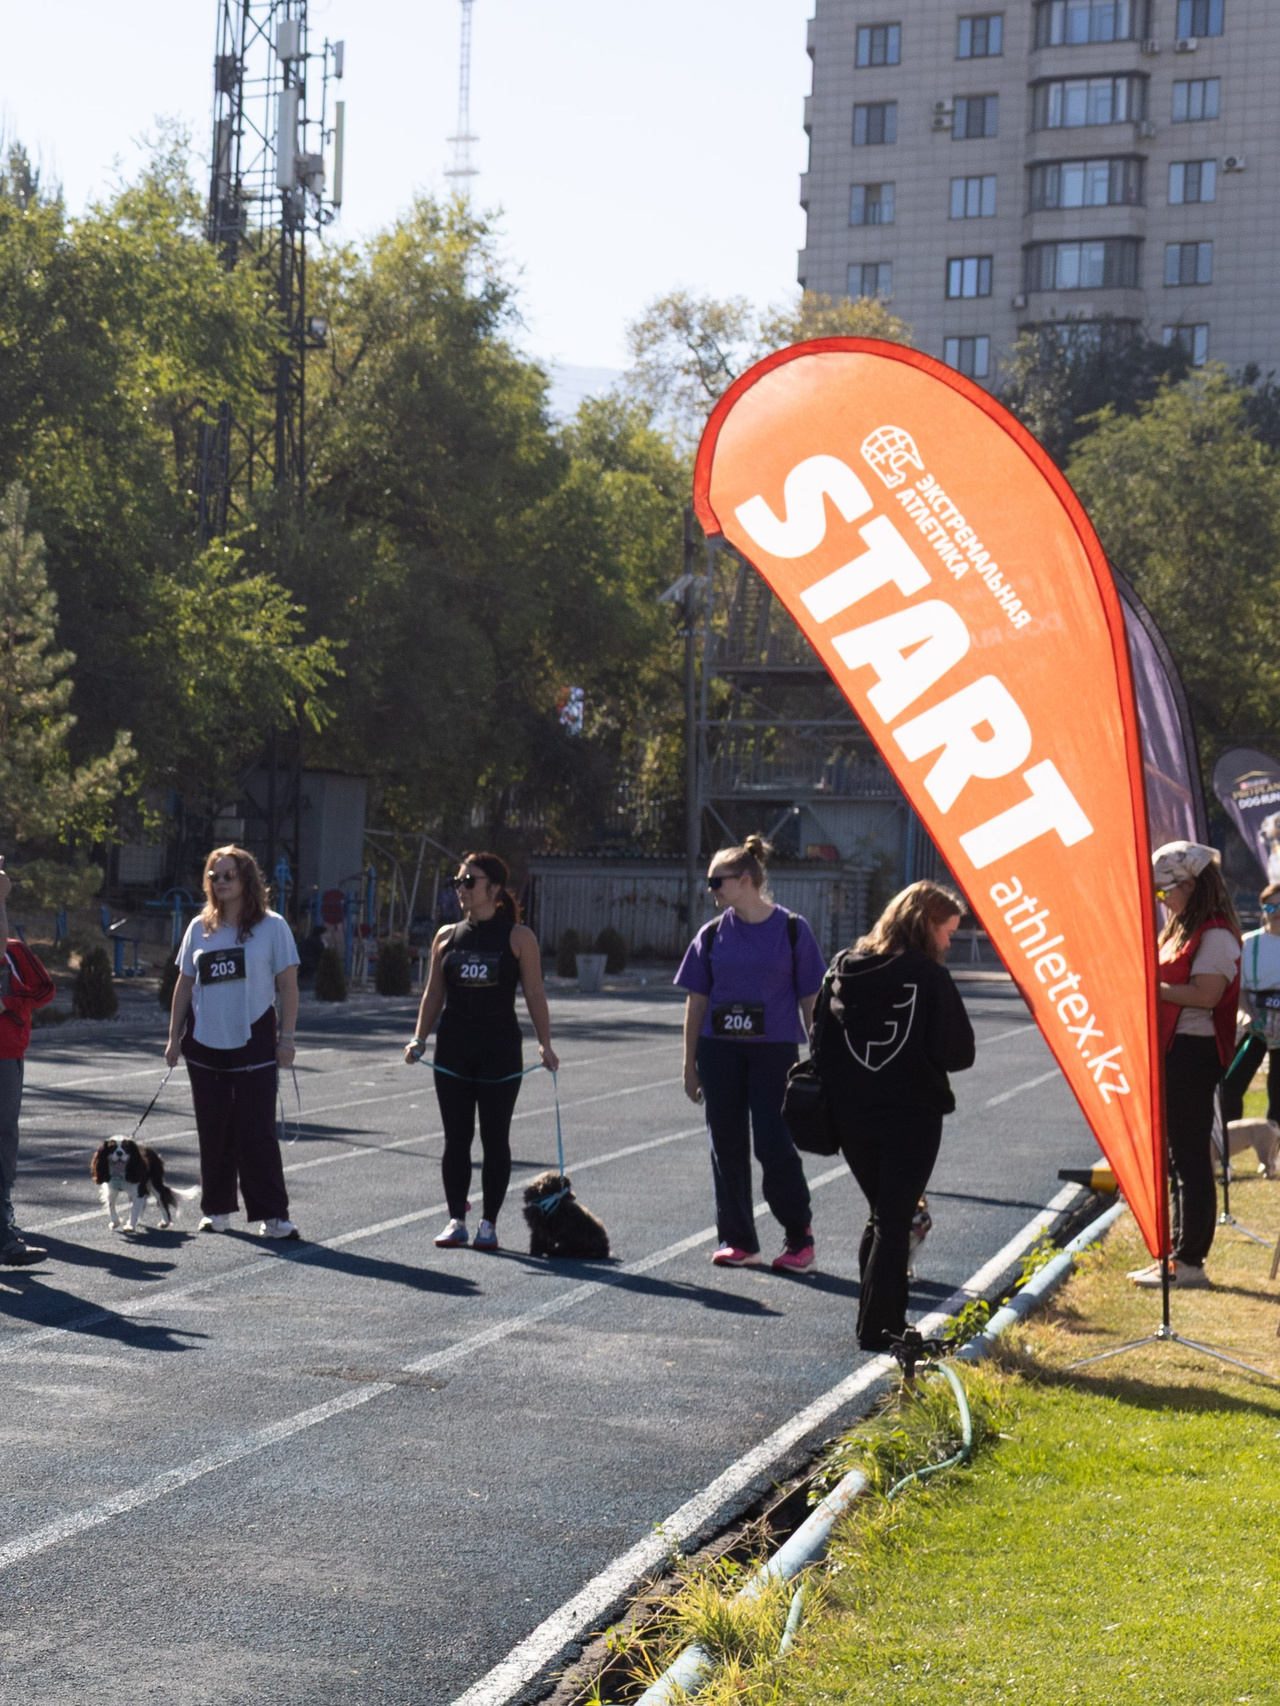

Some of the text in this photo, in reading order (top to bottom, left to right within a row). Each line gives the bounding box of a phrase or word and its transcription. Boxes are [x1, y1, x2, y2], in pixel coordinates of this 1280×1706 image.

[896, 488, 969, 580] АТЛЕТИКА
[915, 474, 1032, 629] ЭКСТРЕМАЛЬНАЯ
[734, 454, 1094, 869] START
[1238, 795, 1261, 809] DOG
[210, 960, 236, 977] 203
[460, 964, 488, 979] 202
[989, 876, 1131, 1105] athletex.kz
[724, 1014, 753, 1030] 206
